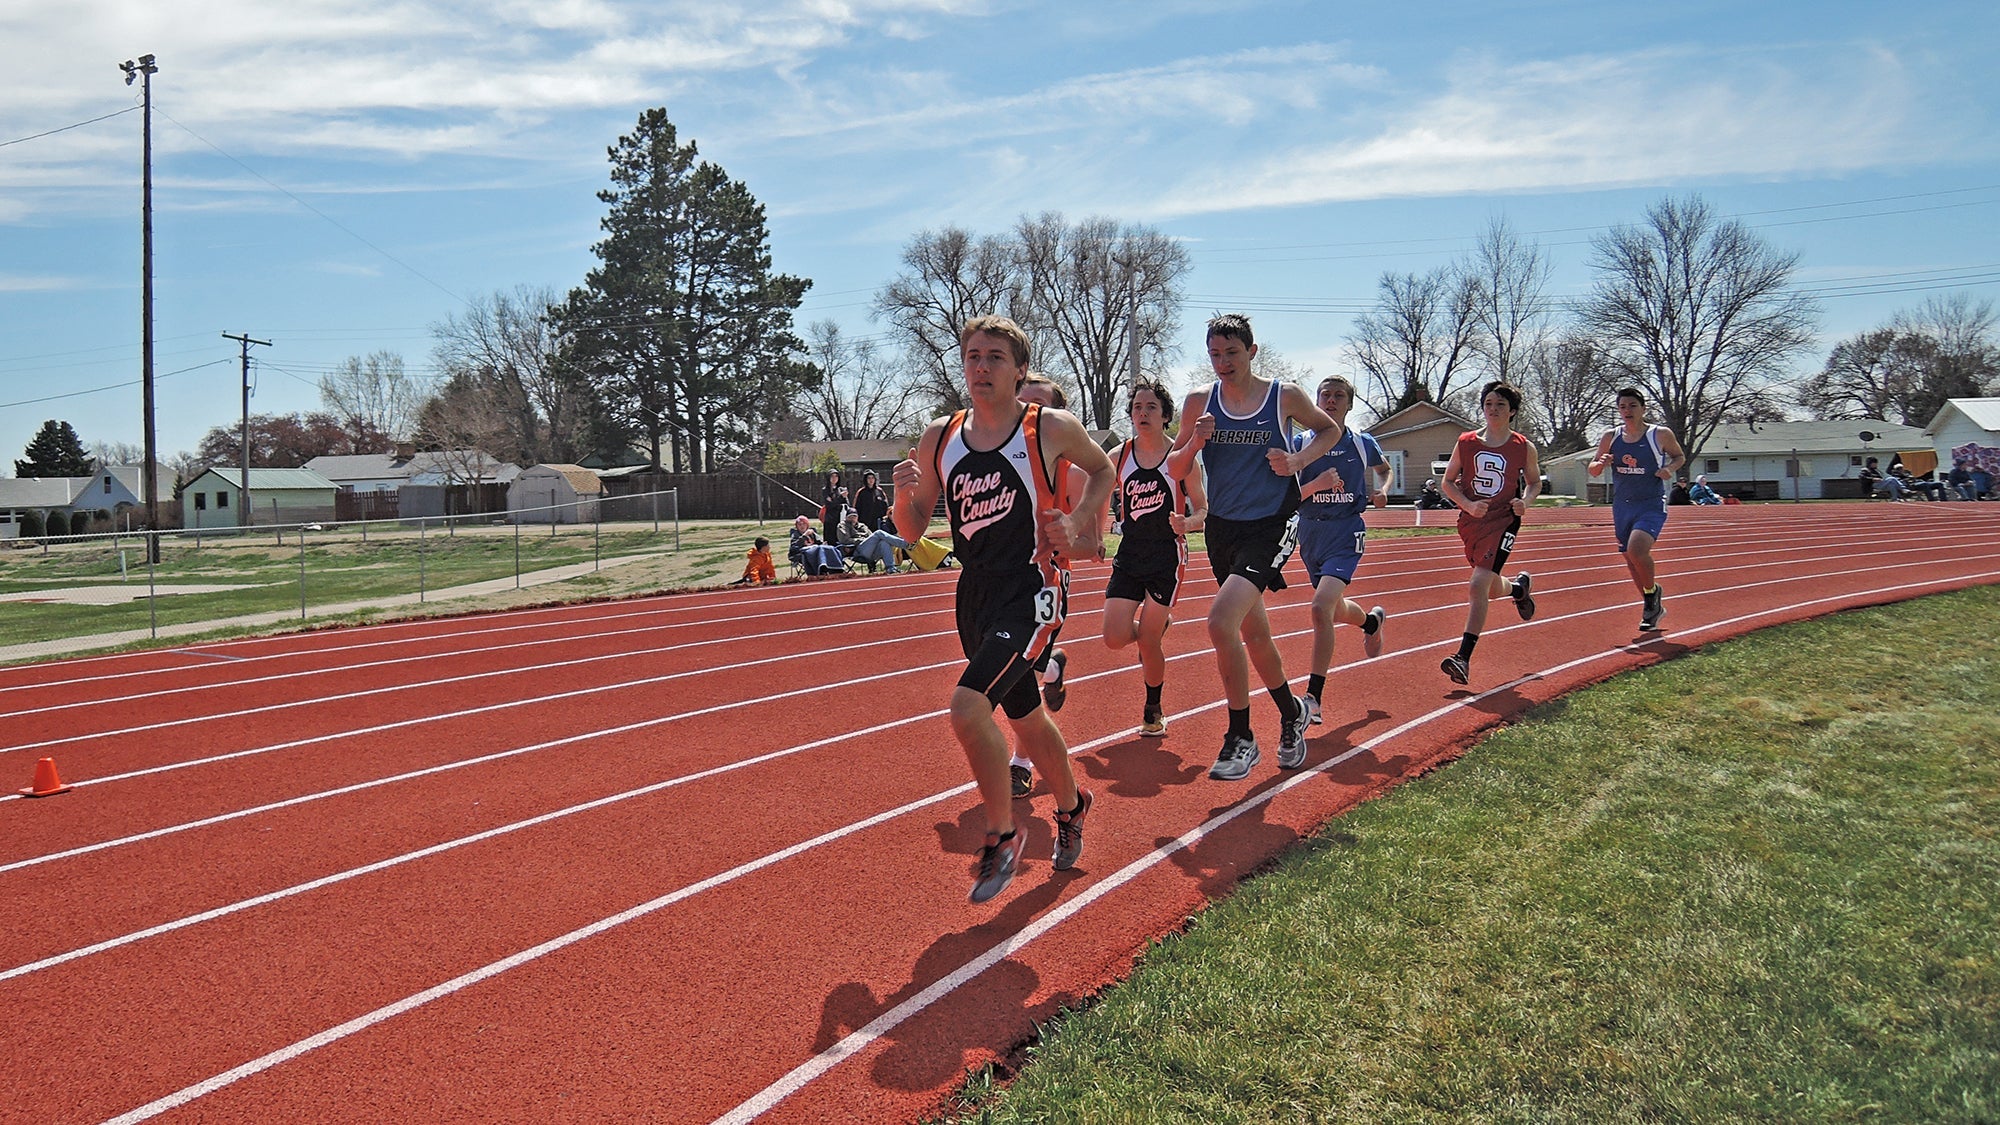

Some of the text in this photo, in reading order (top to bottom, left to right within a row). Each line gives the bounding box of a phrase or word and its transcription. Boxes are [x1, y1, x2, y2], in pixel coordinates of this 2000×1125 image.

[1211, 430, 1272, 445] HERSHEY
[1472, 451, 1507, 498] S
[1616, 467, 1645, 475] MUSTANGS
[953, 471, 1001, 501] Chase
[1126, 480, 1158, 496] Chase
[961, 486, 1017, 522] County
[1130, 490, 1166, 510] County
[1312, 493, 1354, 503] MUSTANGS
[1283, 525, 1297, 549] 14
[1040, 590, 1054, 622] 3
